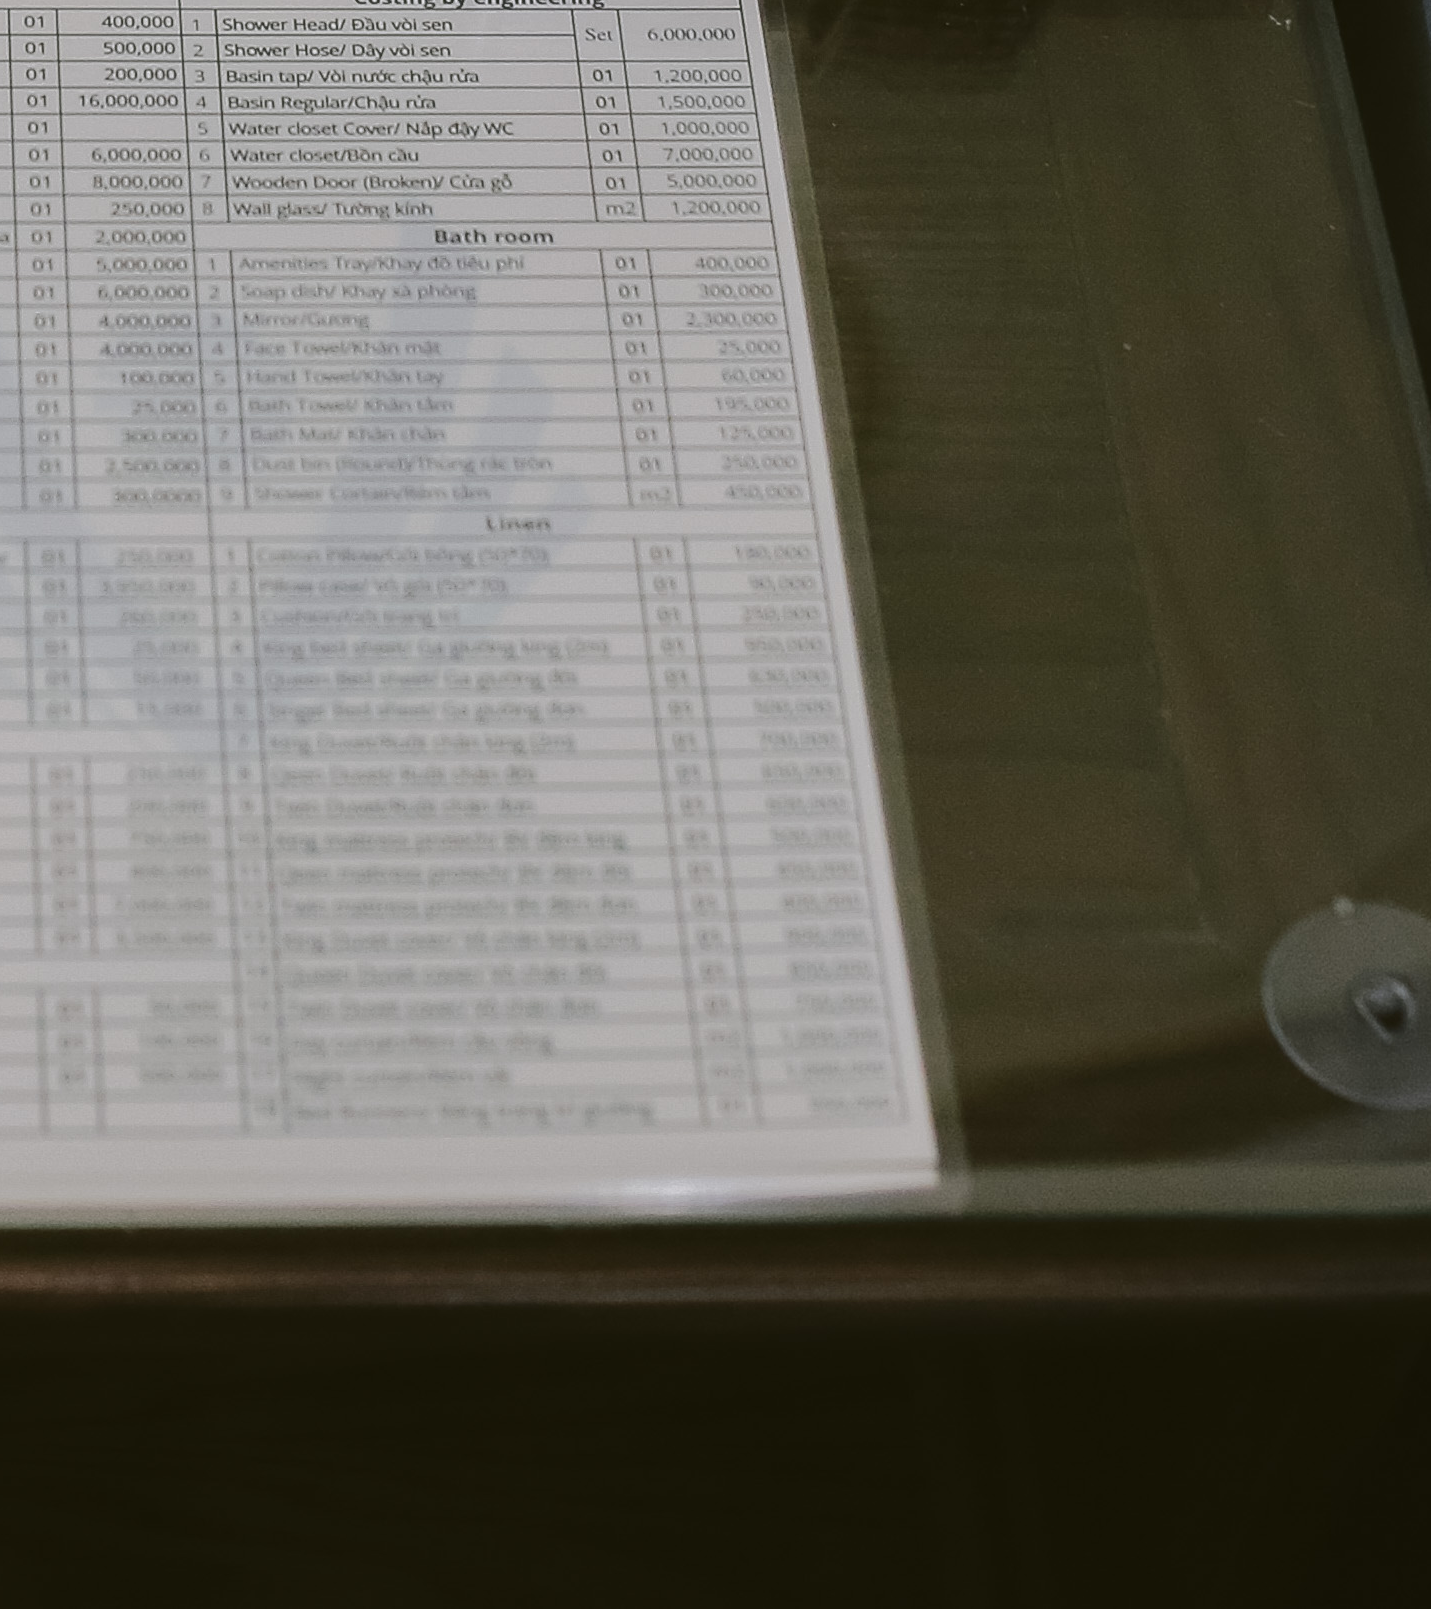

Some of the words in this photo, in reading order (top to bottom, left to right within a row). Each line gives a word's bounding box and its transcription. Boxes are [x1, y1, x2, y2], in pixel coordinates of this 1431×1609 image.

[24, 15, 44, 28] 01
[101, 15, 174, 30] 400,000
[193, 19, 199, 31] 1
[222, 18, 288, 32] Shower
[293, 18, 347, 33] Head/
[422, 22, 453, 32] sen
[585, 28, 613, 42] Set
[647, 27, 736, 42] 6,000,000
[25, 42, 45, 55] 01
[103, 41, 176, 56] 500,000
[193, 44, 204, 57] 2
[224, 44, 289, 57] Shower
[295, 44, 346, 59] Hose/
[420, 49, 451, 57] sen
[26, 68, 46, 81] 01
[104, 68, 177, 83] 200,000
[655, 70, 742, 84] 1,200,000
[79, 94, 179, 109] 16,000,000
[658, 96, 745, 110] 1,500,000
[434, 229, 487, 244] Bath
[495, 233, 554, 244] room
